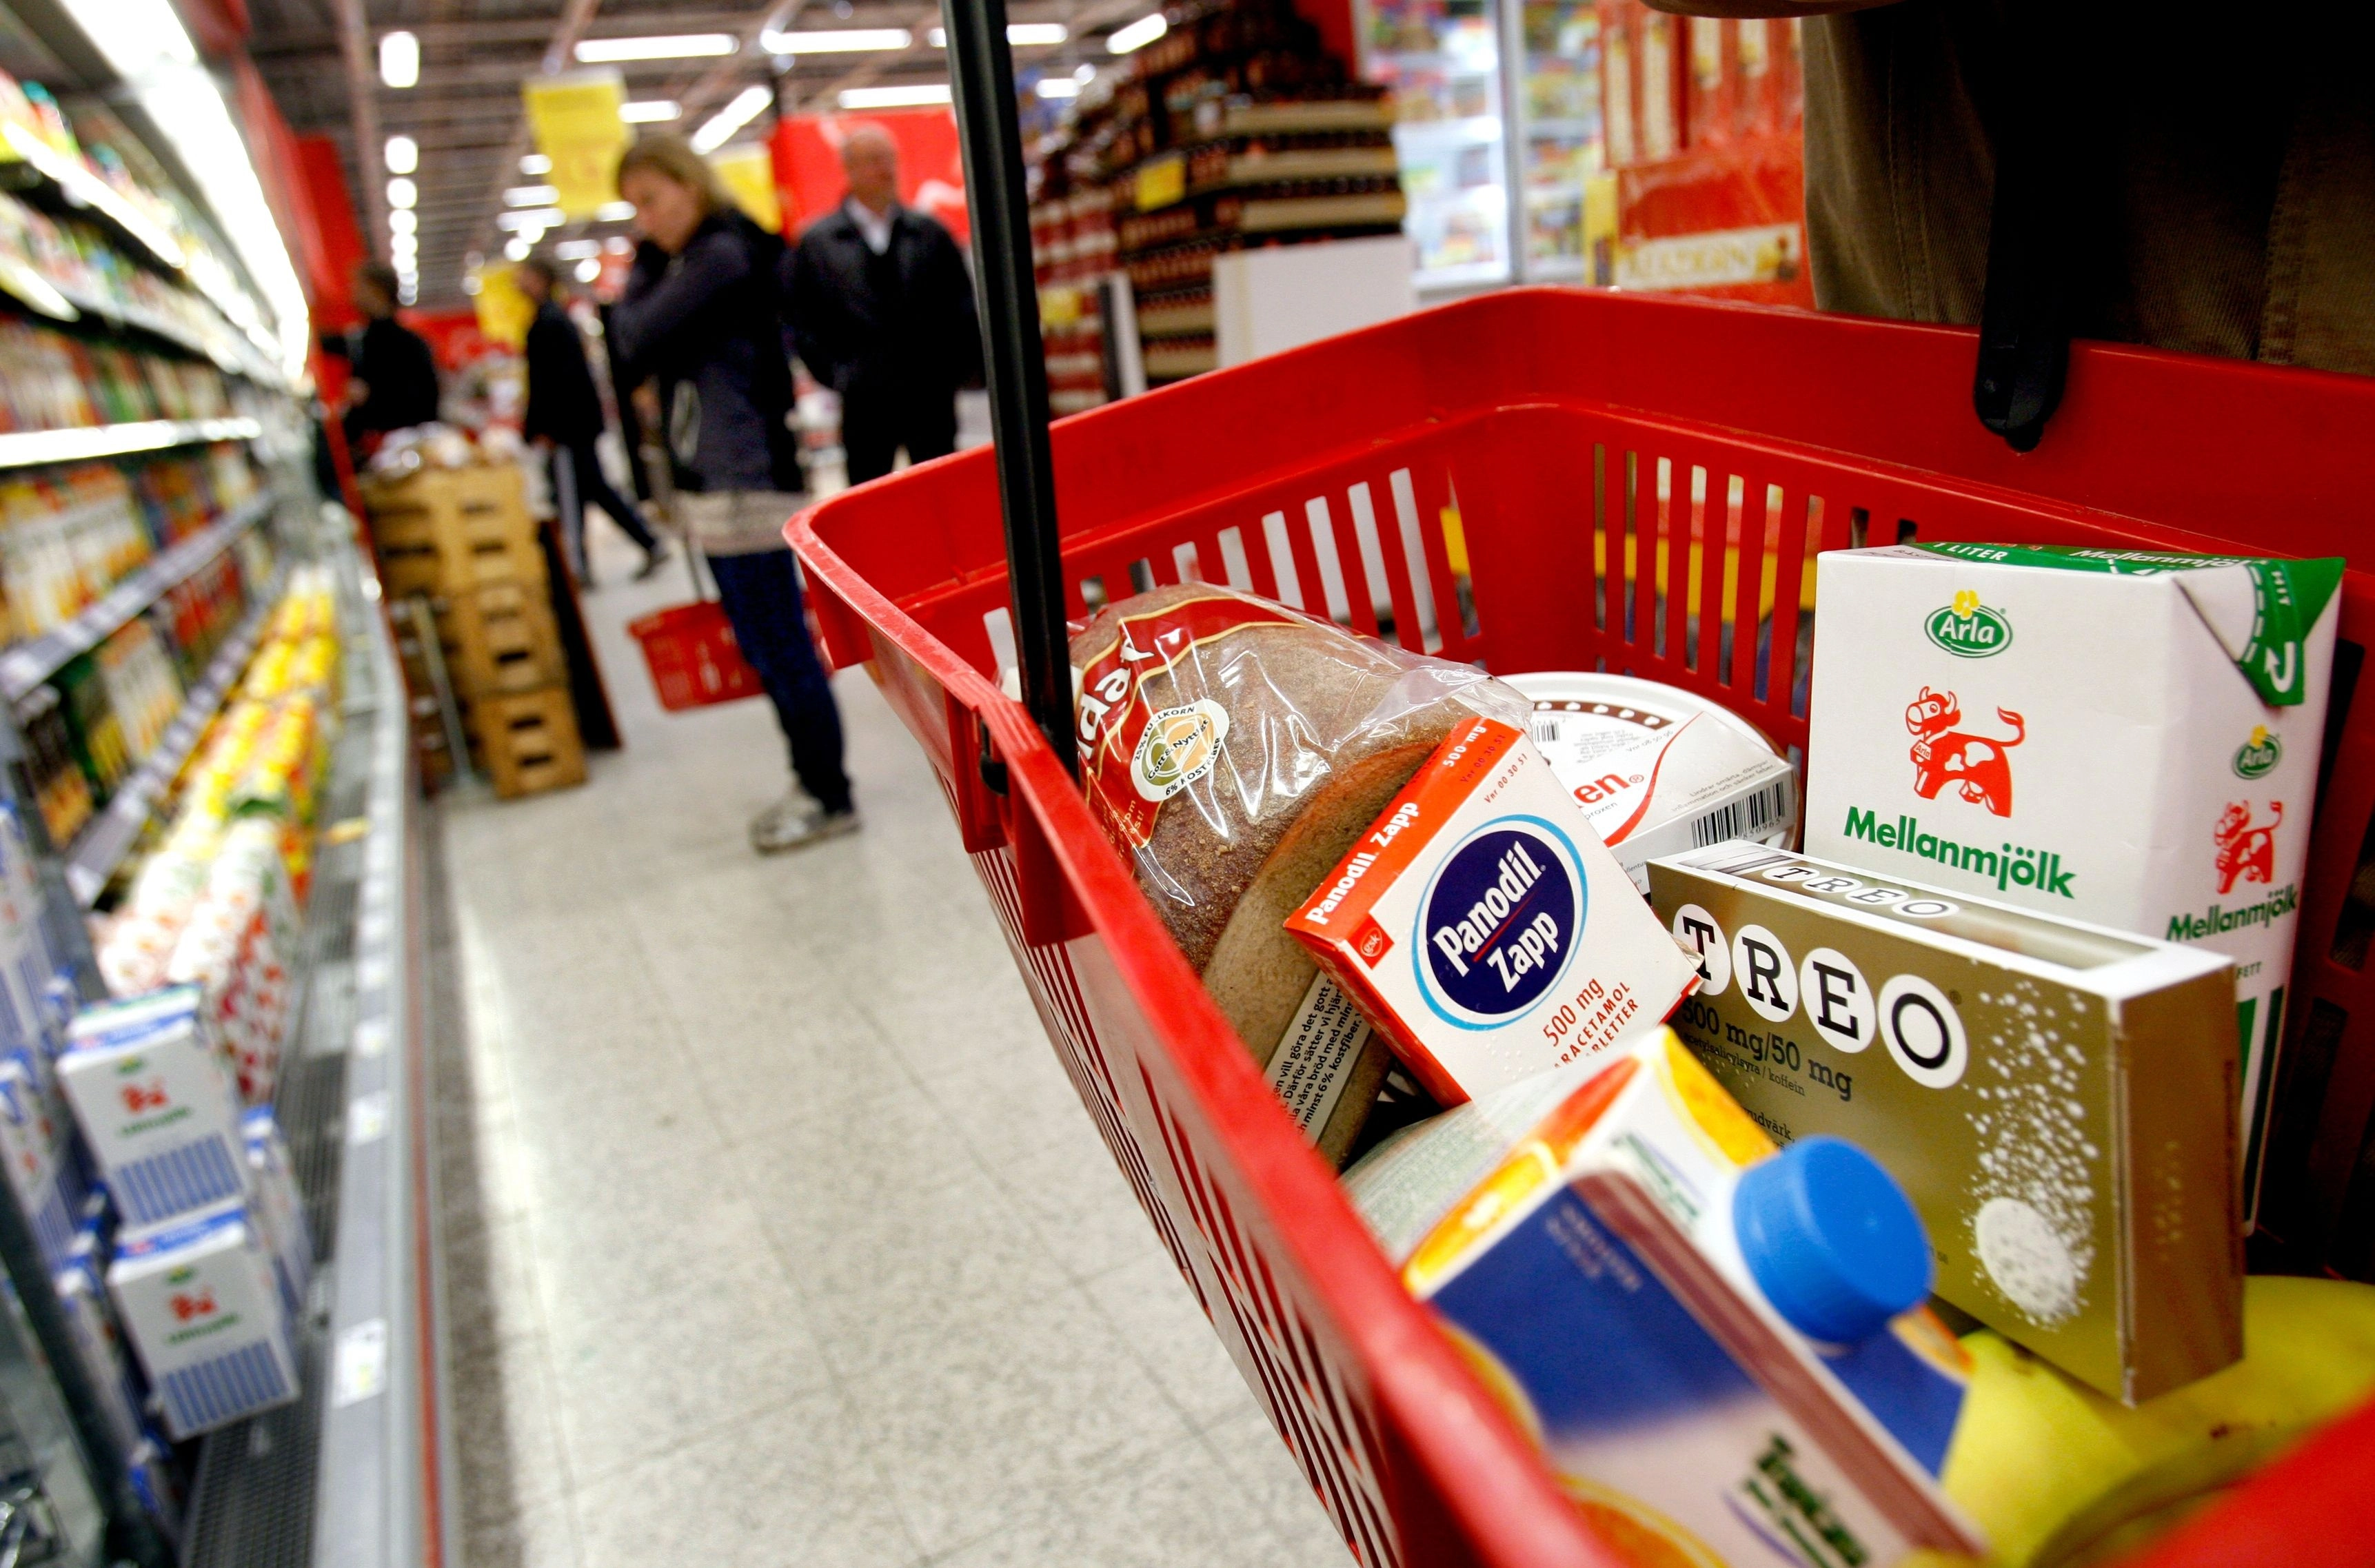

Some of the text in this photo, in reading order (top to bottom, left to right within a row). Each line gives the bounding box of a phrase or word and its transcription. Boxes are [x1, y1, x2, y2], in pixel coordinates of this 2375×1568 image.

[1946, 544, 2009, 561] LITER
[2069, 549, 2268, 567] Mellanmjöl
[1939, 614, 1996, 644] Arla
[1144, 706, 1195, 737] FULKORN
[1148, 755, 1166, 779] Gott
[1173, 719, 1208, 748] Nyttigt
[1443, 726, 1487, 767] 500 mg
[1484, 753, 1528, 804] Vnr 00 30 51
[1915, 744, 1931, 758] Arla
[1166, 783, 1178, 795] 6%
[1584, 802, 1618, 820] proxen
[1305, 802, 1419, 925] Panodil Zapp
[1843, 805, 2077, 899] Mellanmjölk
[1433, 840, 1543, 977] Panodil
[1773, 867, 1949, 915] TREO
[2165, 883, 2298, 941] Mellanmjölk
[1364, 933, 1382, 954] gsk
[1486, 912, 1559, 993] Zapp
[1543, 978, 1605, 1047] 500 mg
[1683, 916, 1952, 1070] TREO
[1272, 1079, 1284, 1101] gen
[1280, 1060, 1294, 1077] vill
[1291, 1035, 1306, 1059] göra
[1302, 1014, 1317, 1032] det
[1314, 986, 1331, 1012] gott
[1297, 1083, 1313, 1106] våra
[1308, 1055, 1327, 1081] bröd
[1326, 1029, 1340, 1053] med
[1340, 1001, 1355, 1029] mins
[1554, 981, 1630, 1068] RACETAMOL
[1586, 999, 1639, 1057] BLETTER
[1682, 1001, 1852, 1102] 500 mg/50 mg
[1284, 1063, 1307, 1099] Därför
[1304, 1029, 1324, 1062] sätter
[1322, 1016, 1331, 1027] vi
[1304, 1092, 1324, 1123] minst
[1329, 1020, 1362, 1070] kostfiber.
[1768, 1068, 1806, 1097] koffein
[1744, 1107, 1795, 1143] udvärk,
